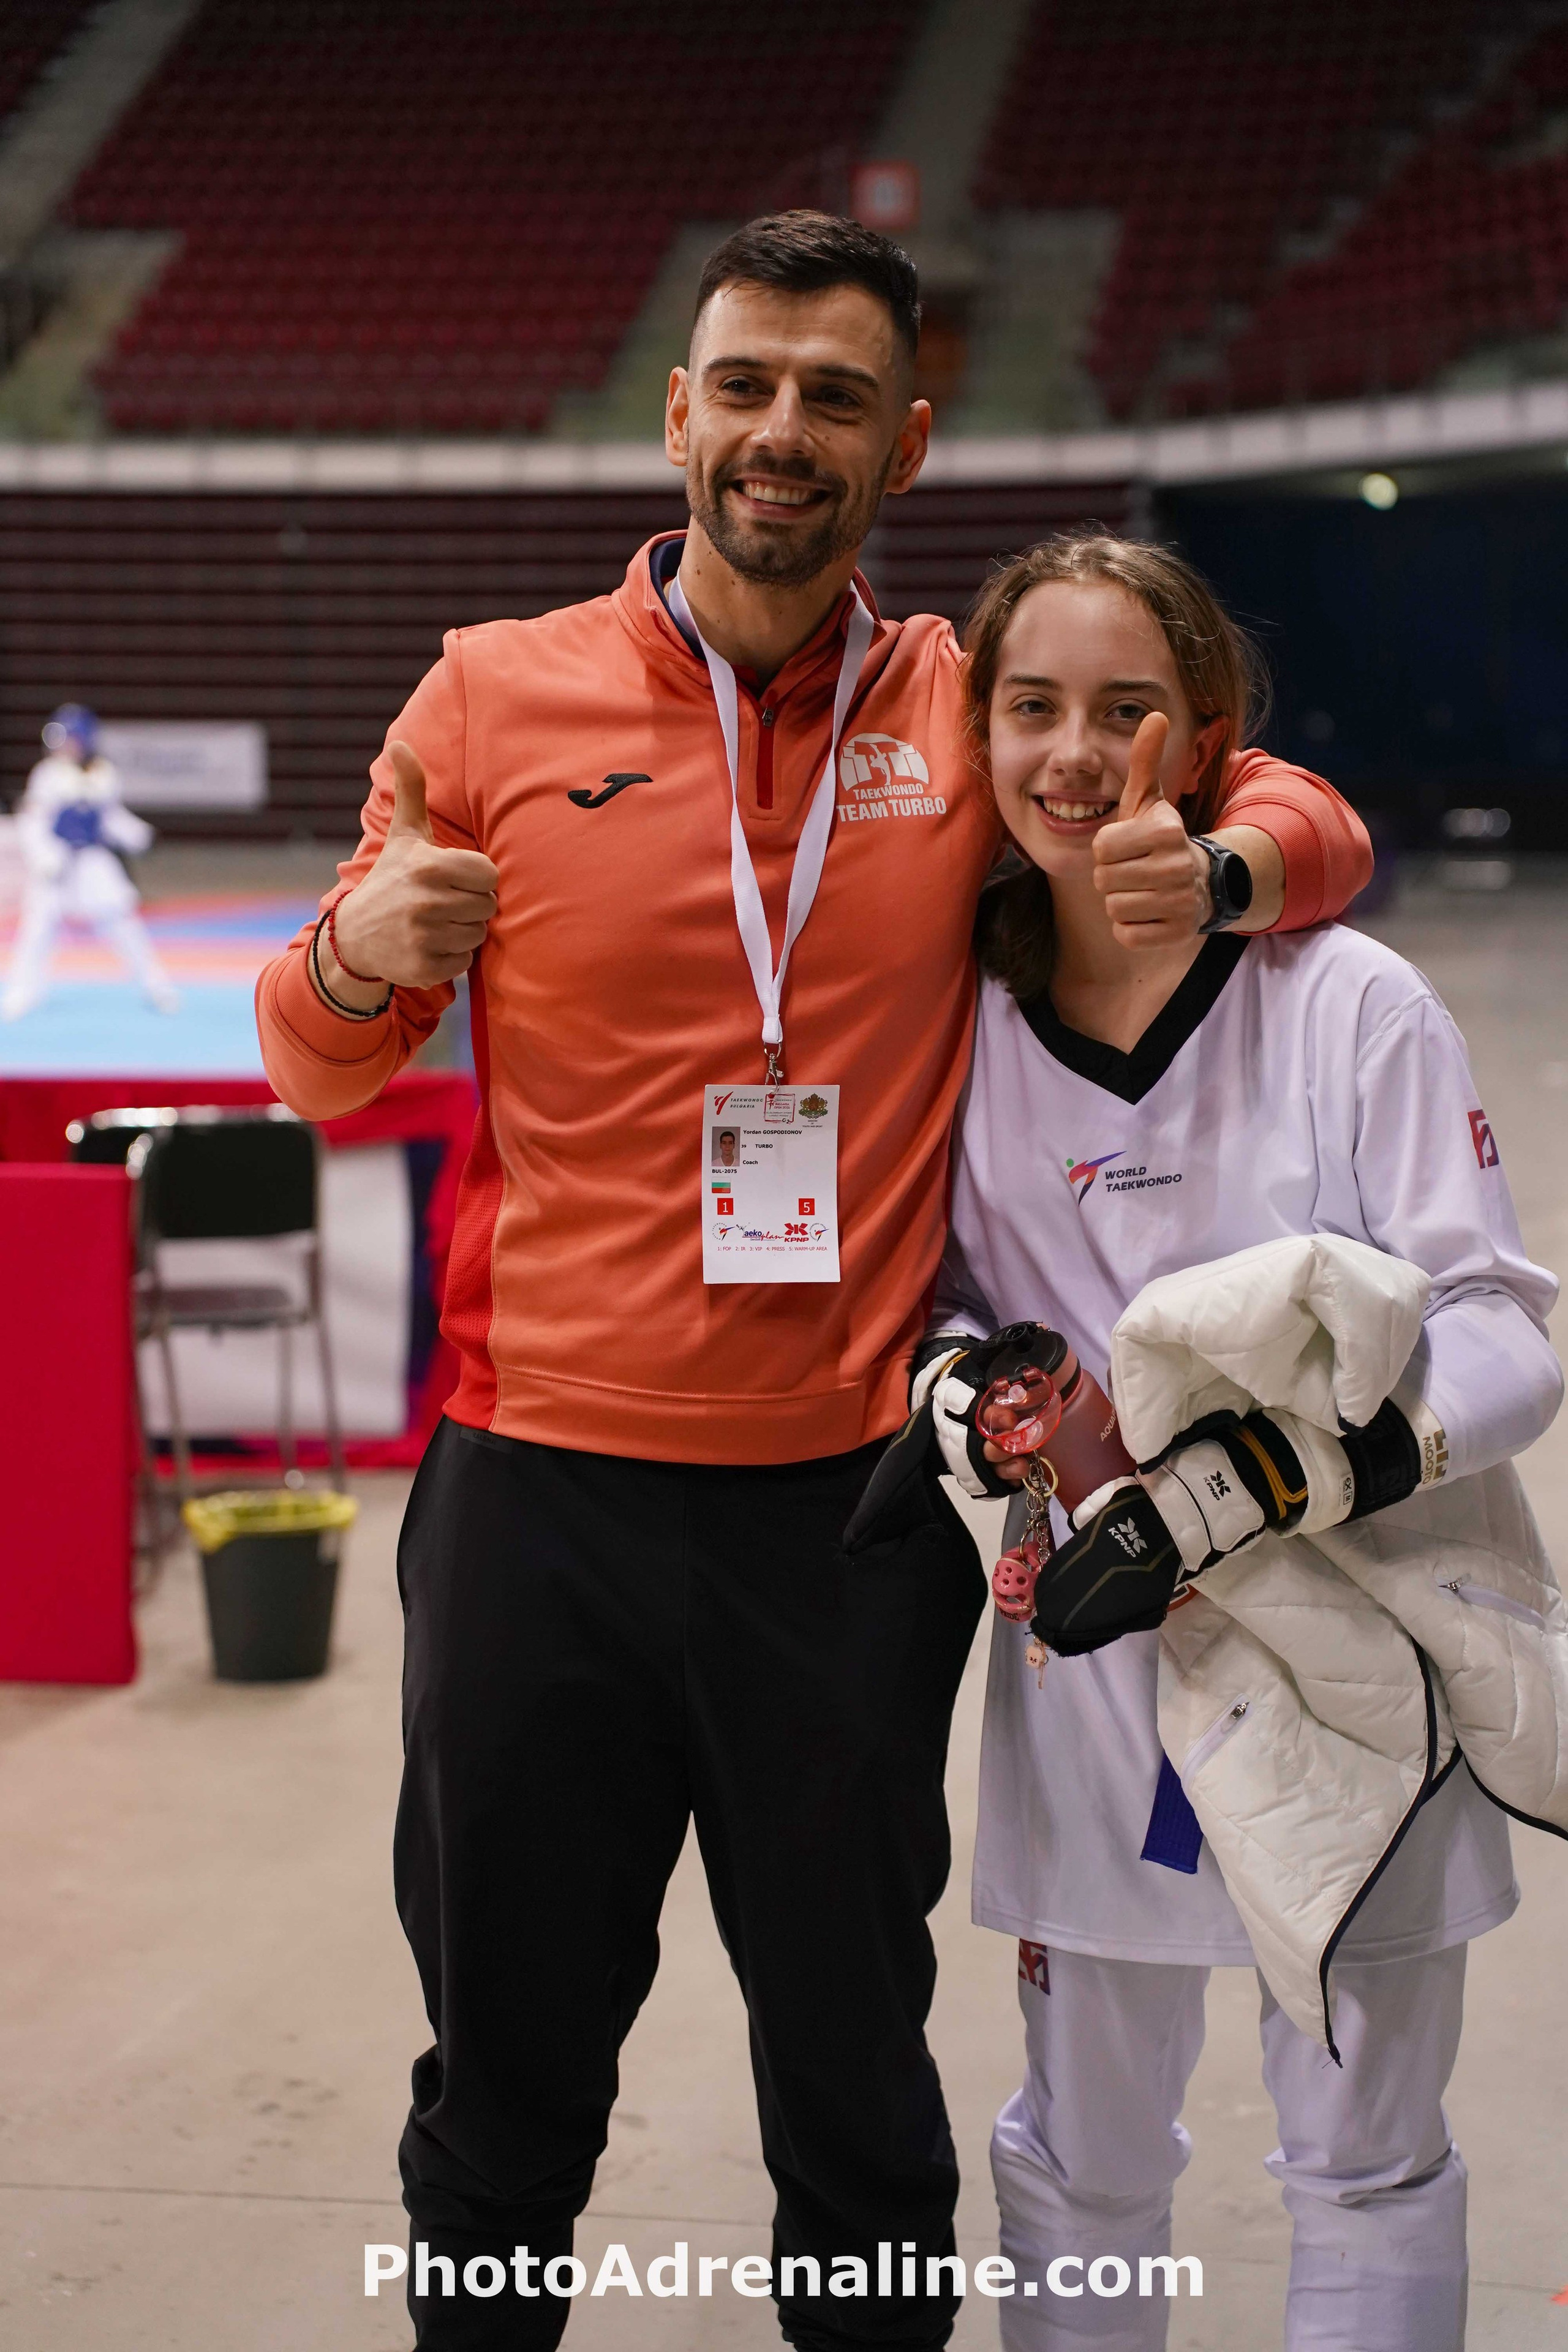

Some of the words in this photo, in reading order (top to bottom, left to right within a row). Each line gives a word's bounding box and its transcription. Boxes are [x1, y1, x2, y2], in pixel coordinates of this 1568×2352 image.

[853, 783, 924, 800] TAEKWONDO
[836, 801, 888, 822] TEAM
[888, 796, 947, 816] TURBO
[1105, 1167, 1147, 1180] WORLD
[1106, 1174, 1182, 1192] TAEKWONDO
[723, 1202, 728, 1213] 1
[803, 1202, 810, 1213] 5
[1422, 1436, 1434, 1485] MOOTO
[1203, 1477, 1220, 1501] KPNP
[1108, 1527, 1137, 1558] KPNP
